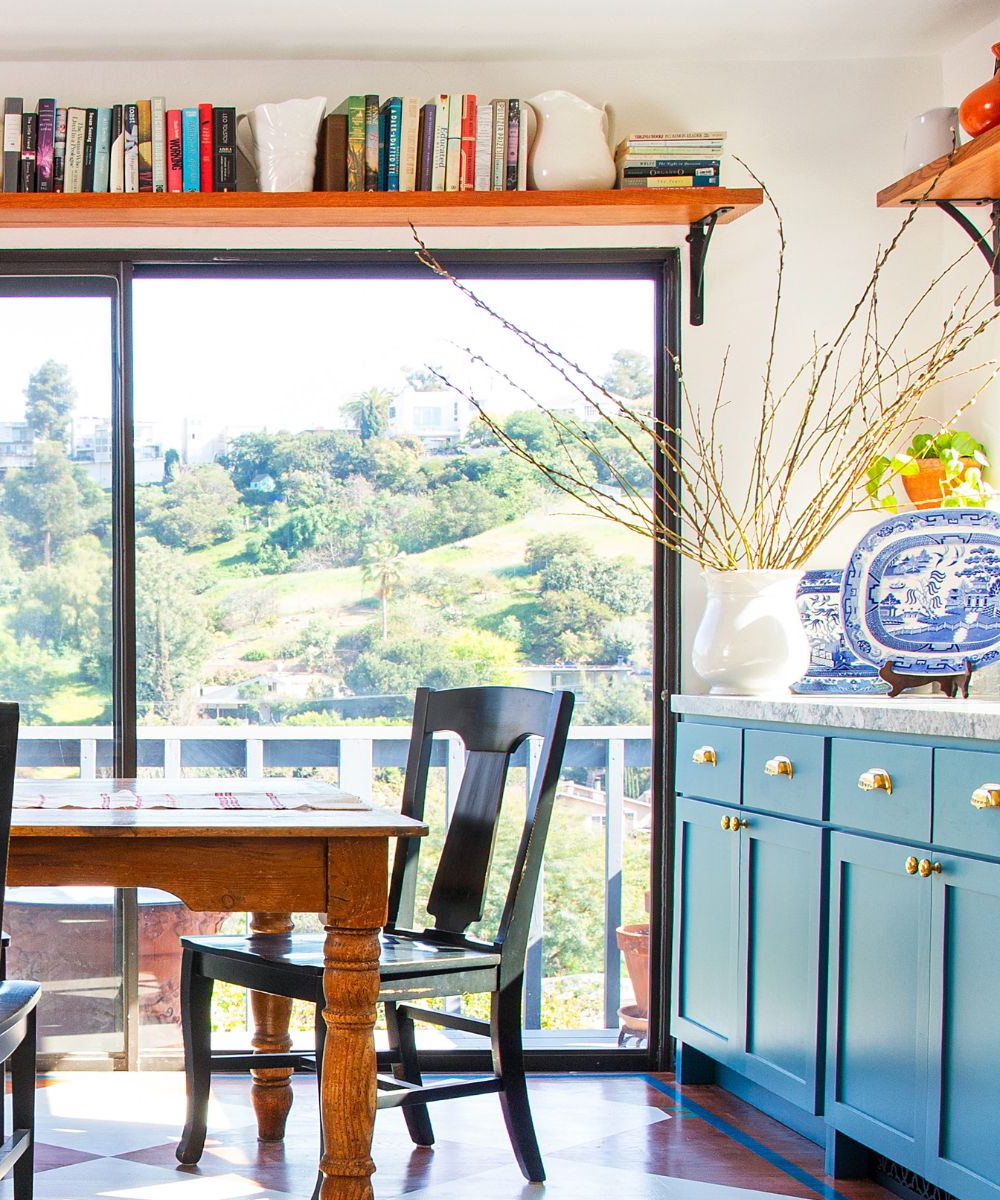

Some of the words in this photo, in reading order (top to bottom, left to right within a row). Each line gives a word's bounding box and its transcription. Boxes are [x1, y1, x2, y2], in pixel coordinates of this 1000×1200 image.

[170, 138, 182, 171] WORKING
[389, 115, 397, 162] DARK-ADAPTED
[438, 127, 448, 168] Educated
